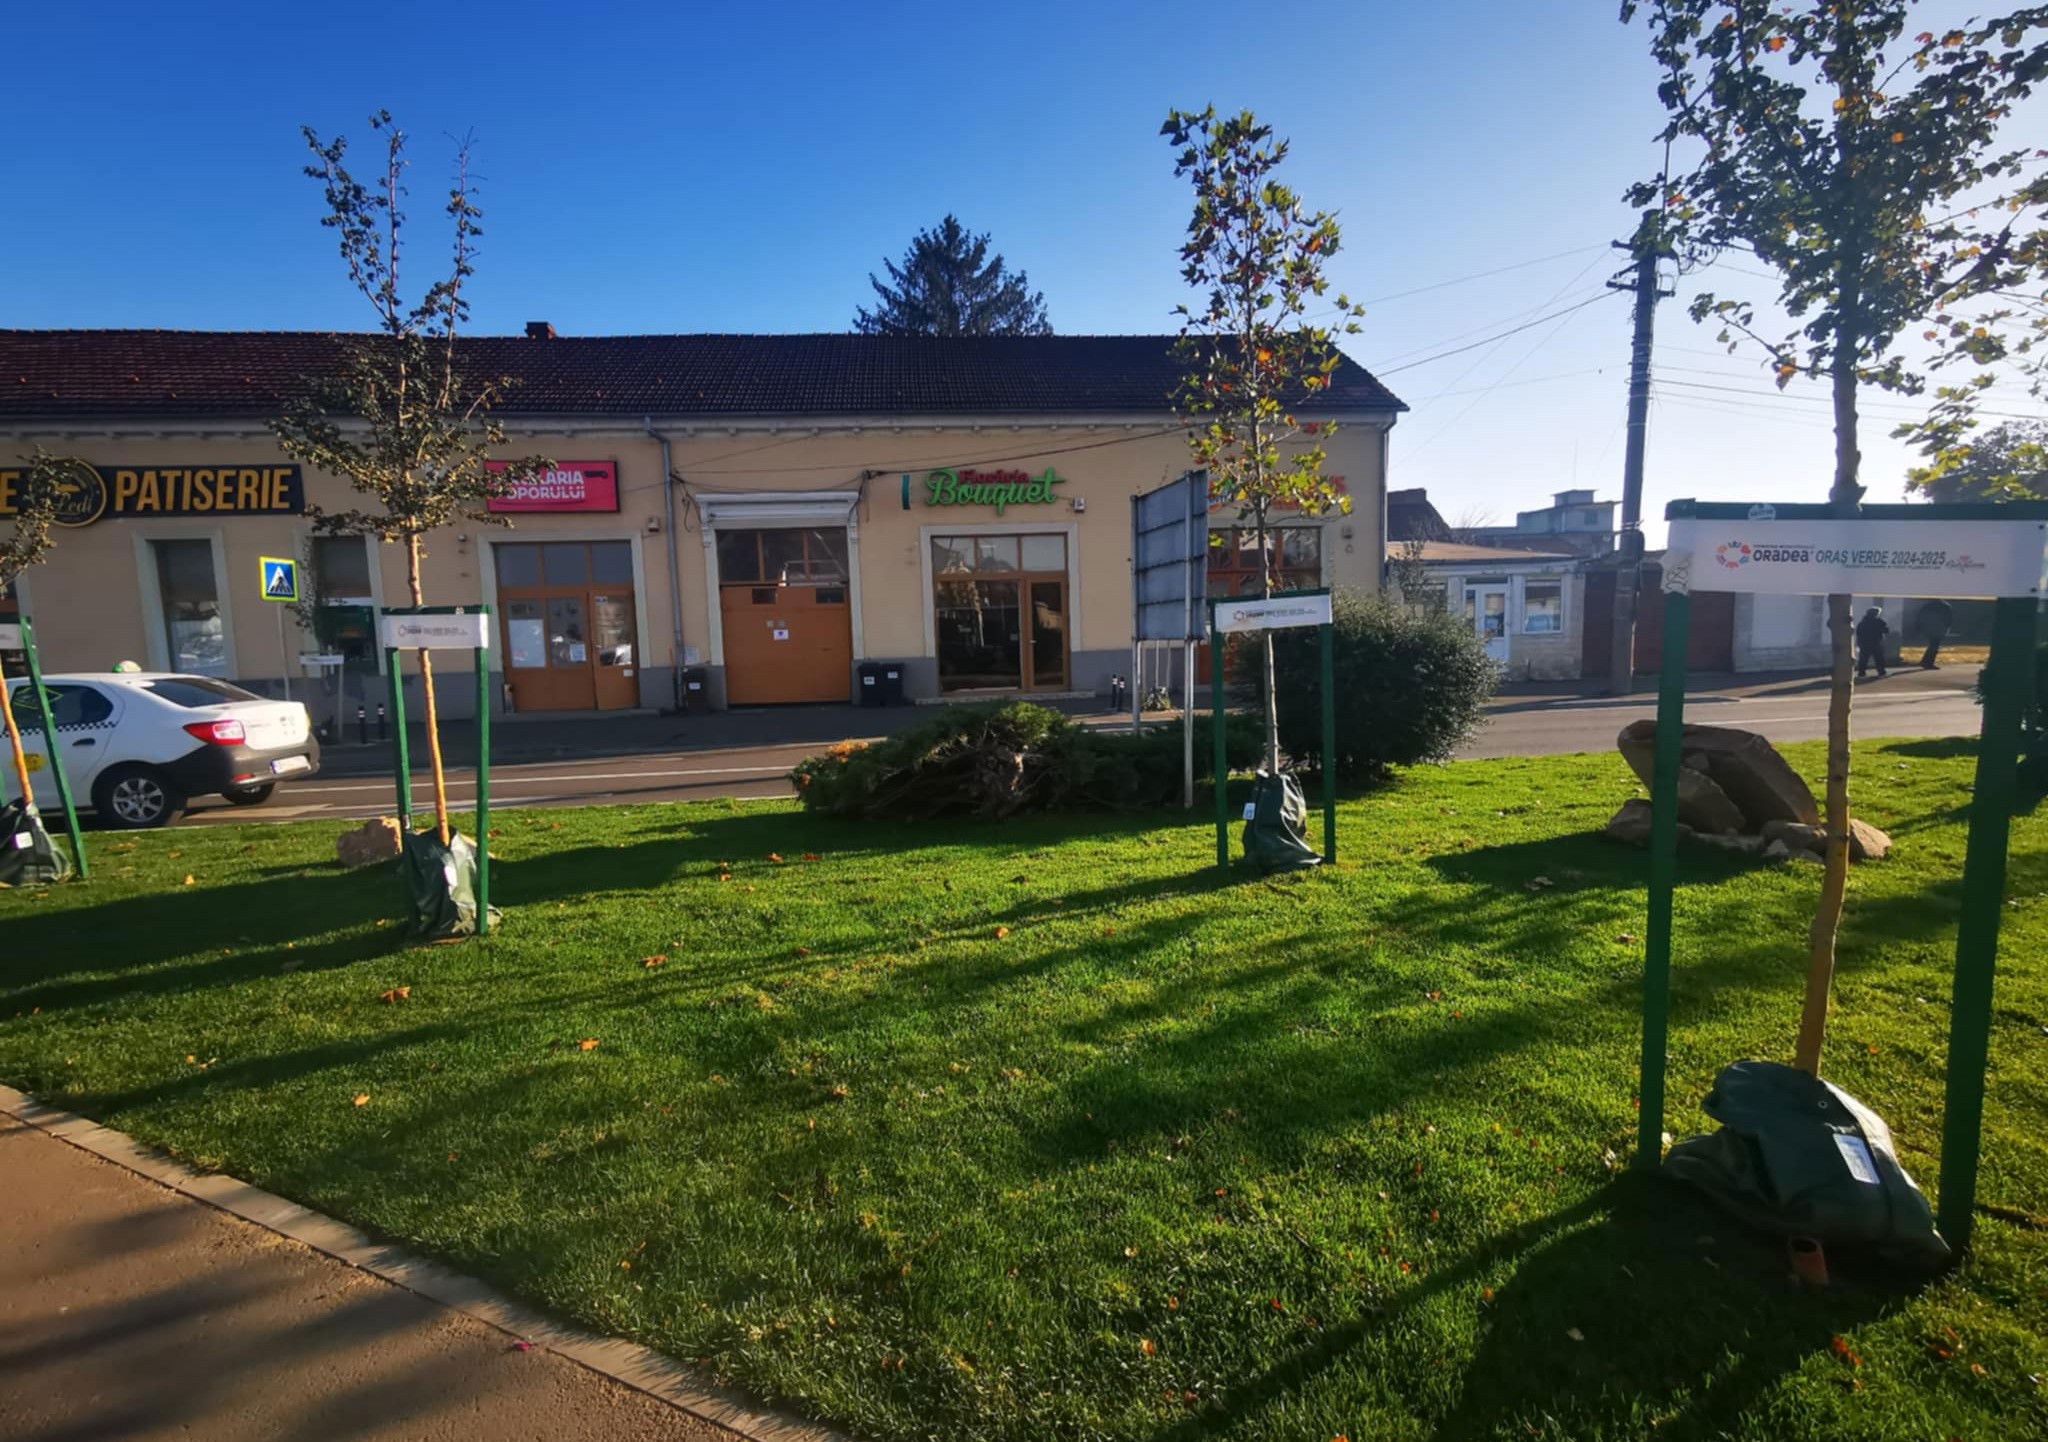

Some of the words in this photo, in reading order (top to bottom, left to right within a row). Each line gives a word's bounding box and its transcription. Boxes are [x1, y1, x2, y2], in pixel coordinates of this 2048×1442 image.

[114, 469, 293, 511] PATISERIE
[925, 467, 1067, 517] Bouquet
[1852, 550, 1888, 564] VERDE
[1891, 551, 1946, 565] 2024-2025
